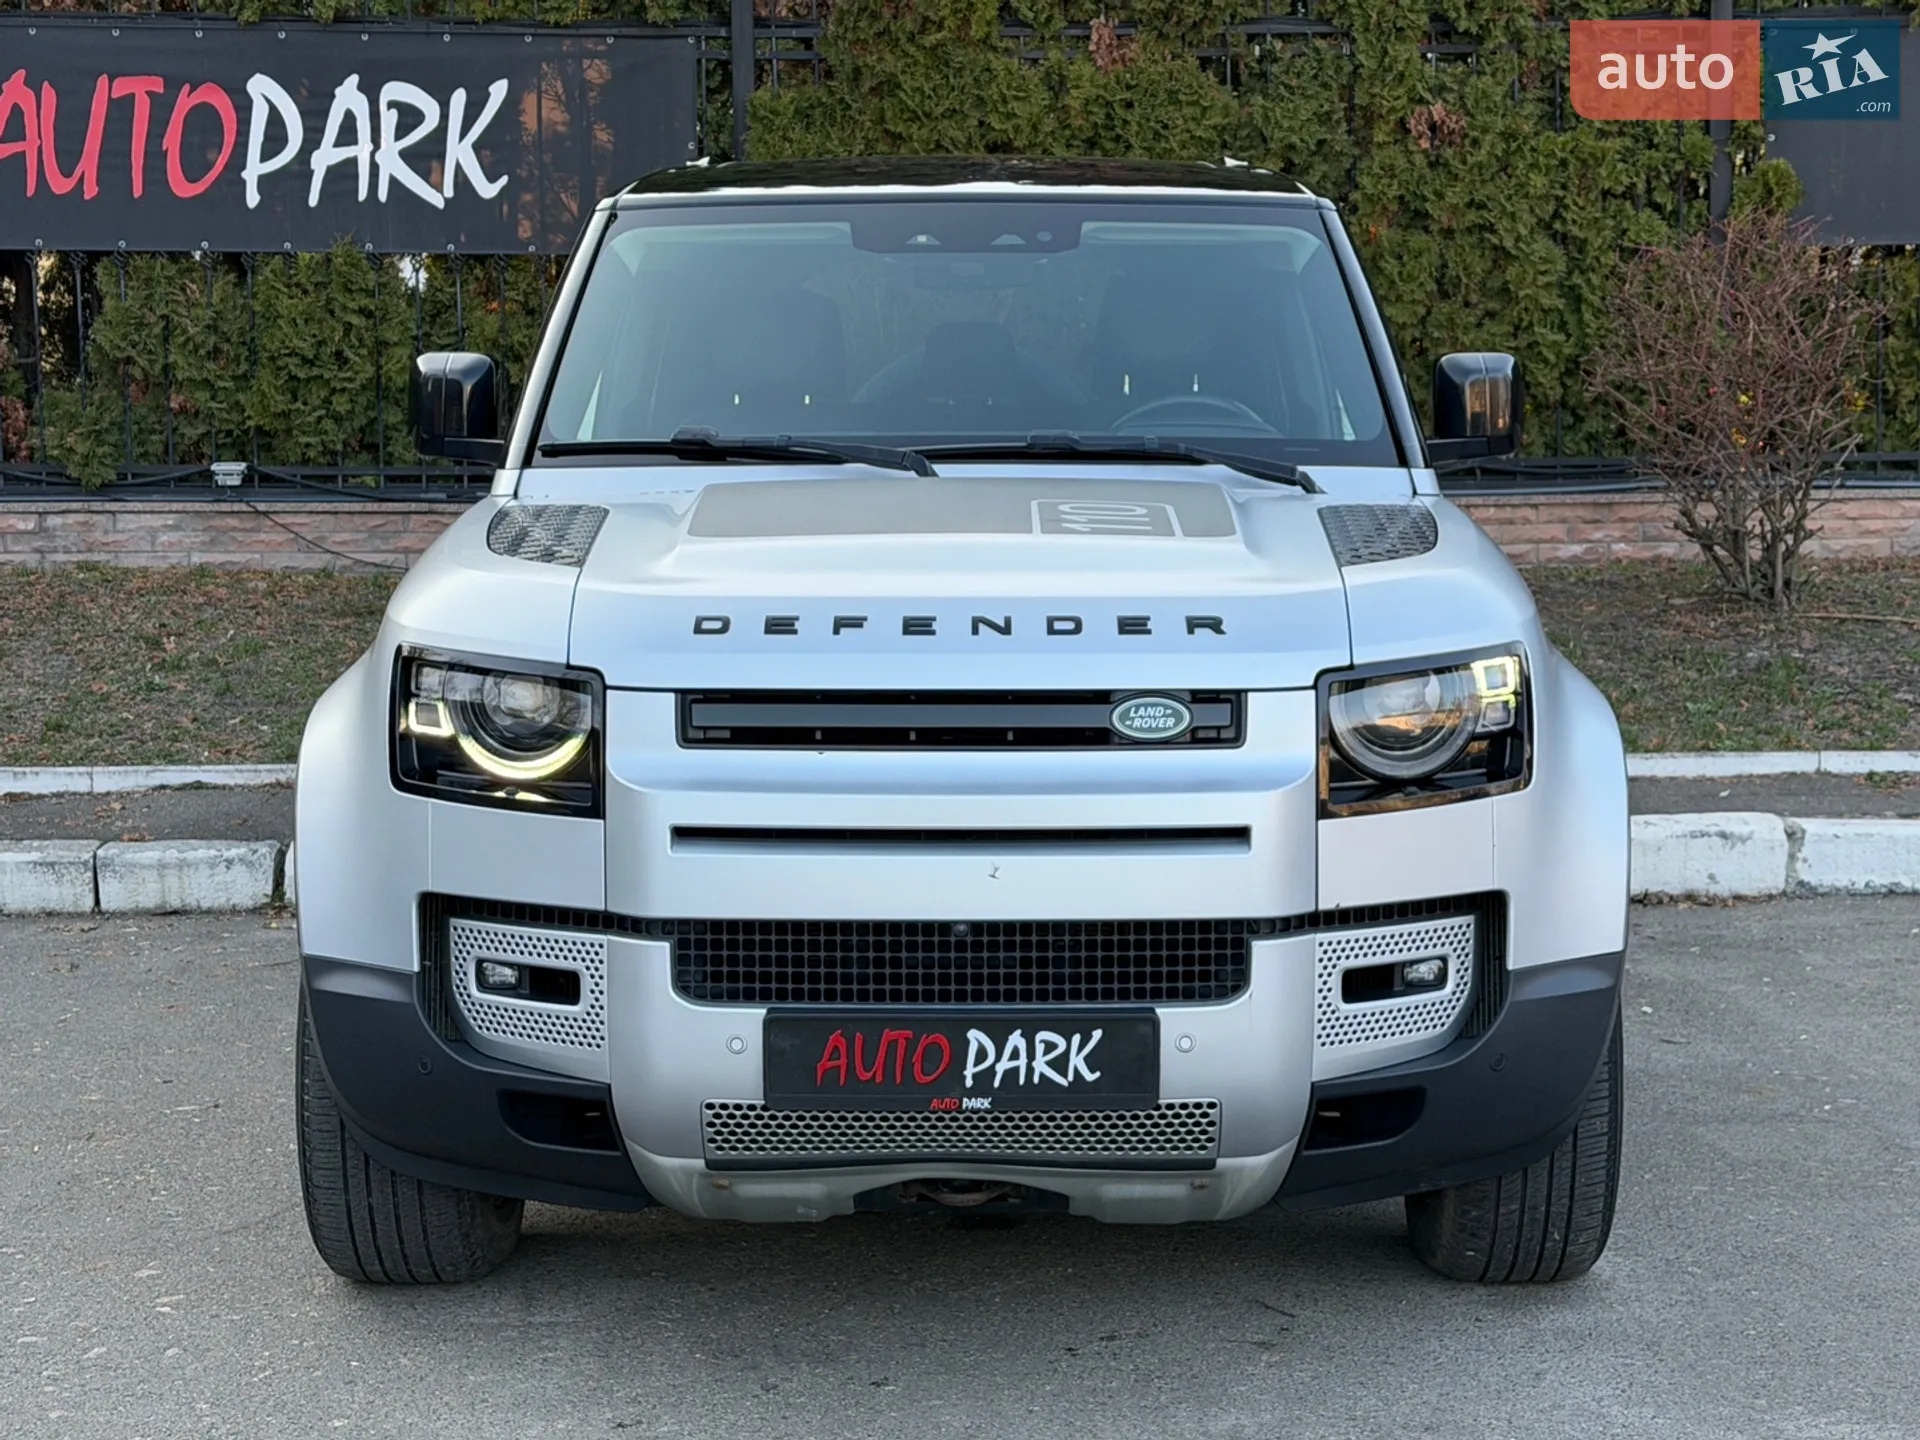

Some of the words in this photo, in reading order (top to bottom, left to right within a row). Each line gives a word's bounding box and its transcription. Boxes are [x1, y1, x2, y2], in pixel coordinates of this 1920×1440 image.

[1058, 503, 1152, 531] 110
[693, 614, 1227, 636] DEFENDER
[1129, 706, 1164, 717] LAND
[1132, 717, 1175, 728] ROVER
[816, 1029, 951, 1087] AUTO
[963, 1028, 1103, 1087] PARK
[930, 1098, 960, 1110] AUTO
[962, 1097, 992, 1110] PARK
